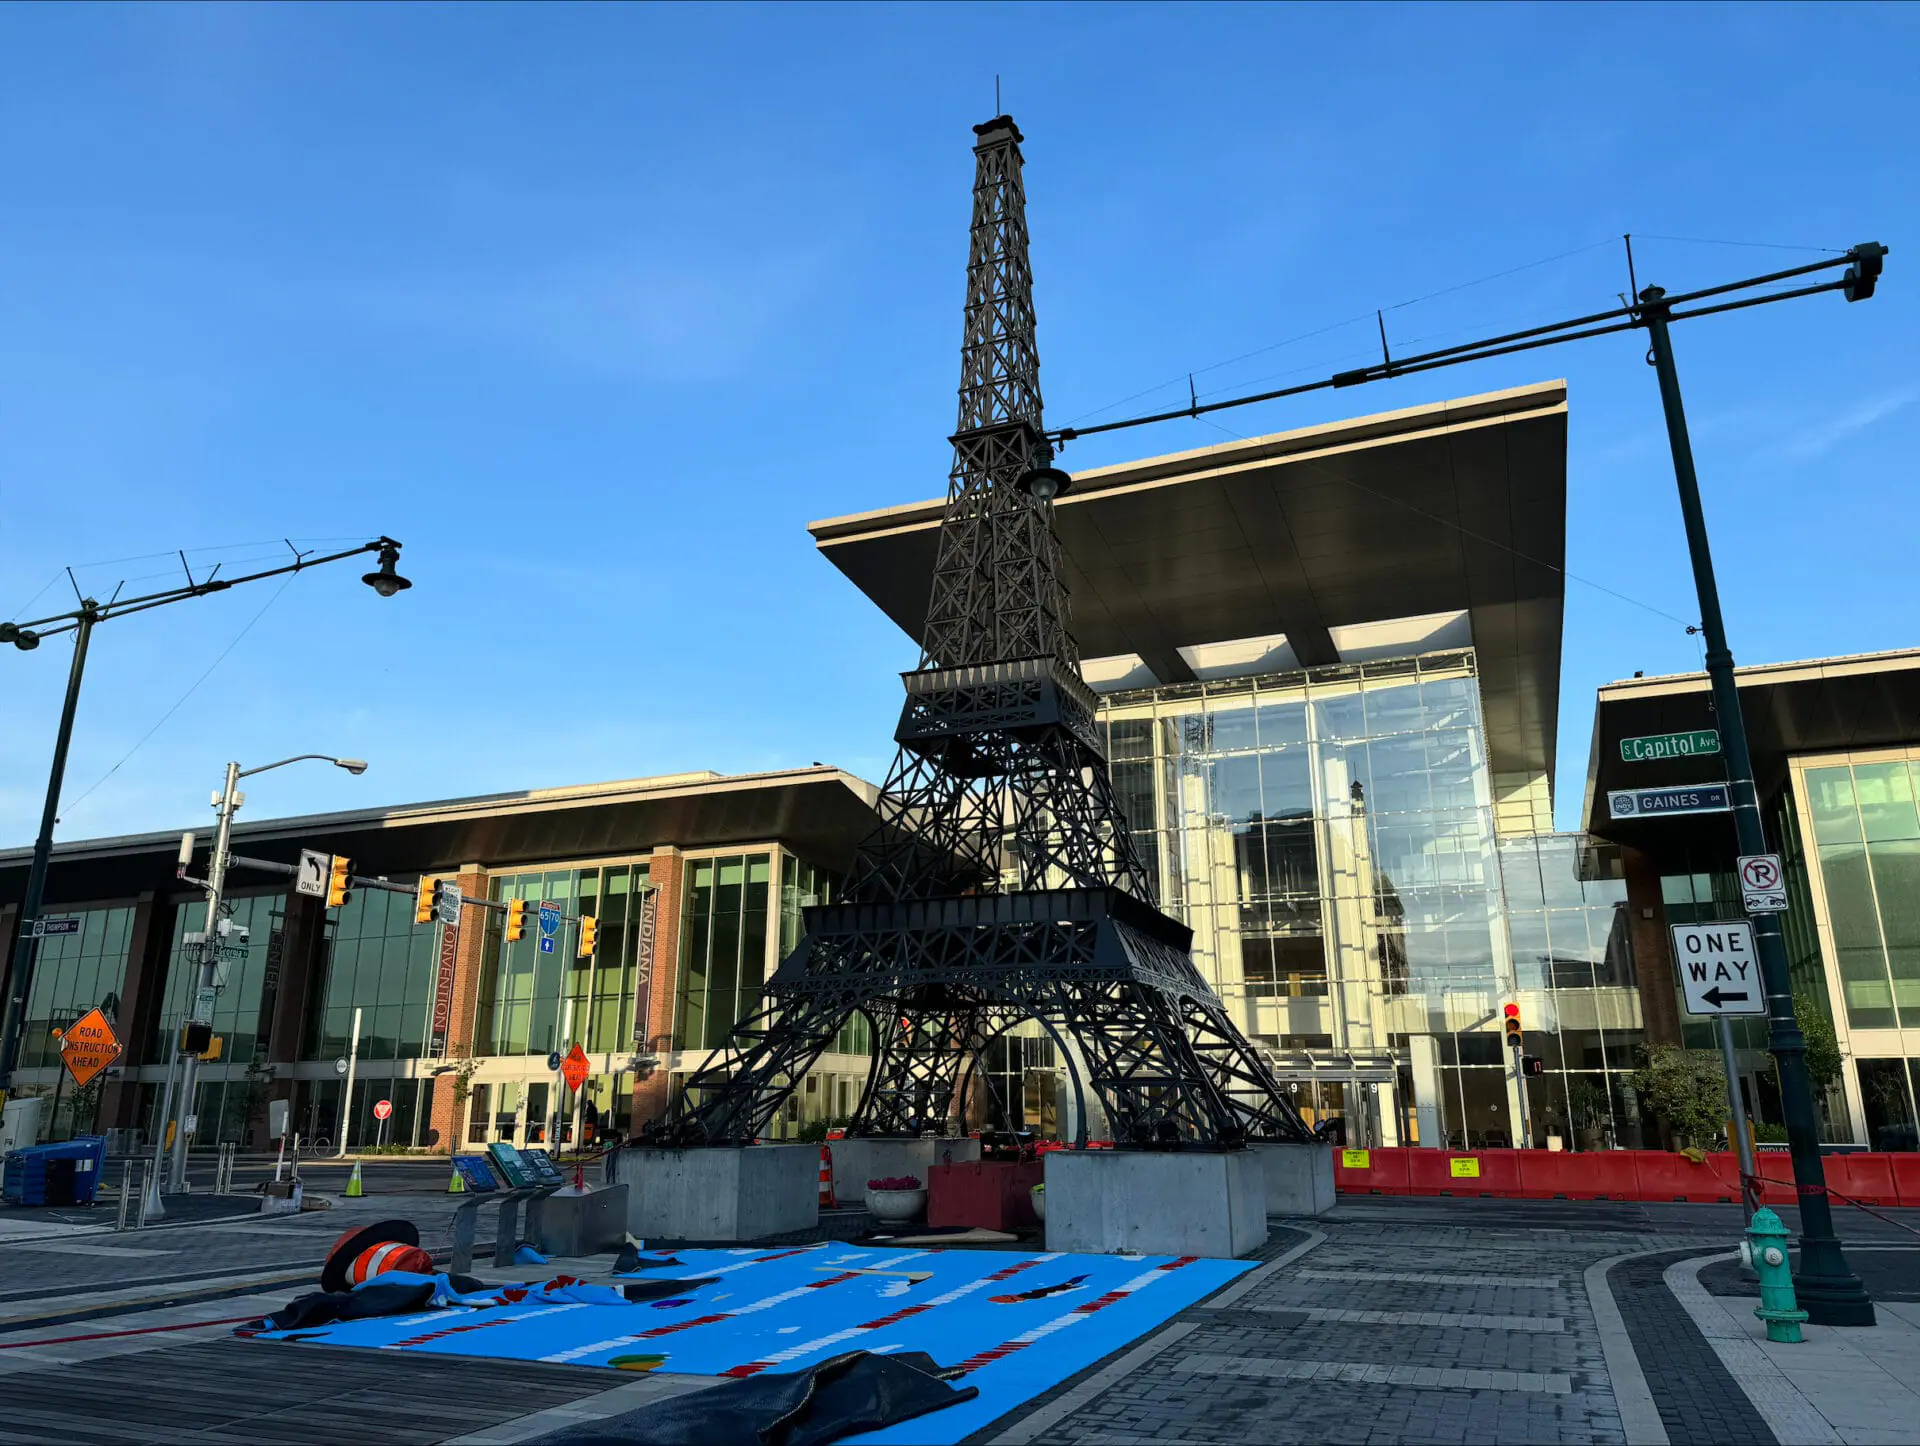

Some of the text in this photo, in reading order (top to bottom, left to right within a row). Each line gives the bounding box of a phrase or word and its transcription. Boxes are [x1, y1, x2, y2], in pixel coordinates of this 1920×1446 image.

[1624, 735, 1716, 758] S Capitol Ave
[1642, 794, 1700, 809] GAINES
[301, 881, 321, 893] ONLY
[540, 911, 560, 923] 65 70
[639, 904, 654, 985] INDIANA
[1685, 932, 1744, 954] ONE
[1688, 960, 1750, 982] WAY
[79, 1027, 103, 1038] ROAD
[72, 1056, 100, 1068] AHEAD
[1290, 1082, 1298, 1093] 9
[1370, 1083, 1378, 1093] 9
